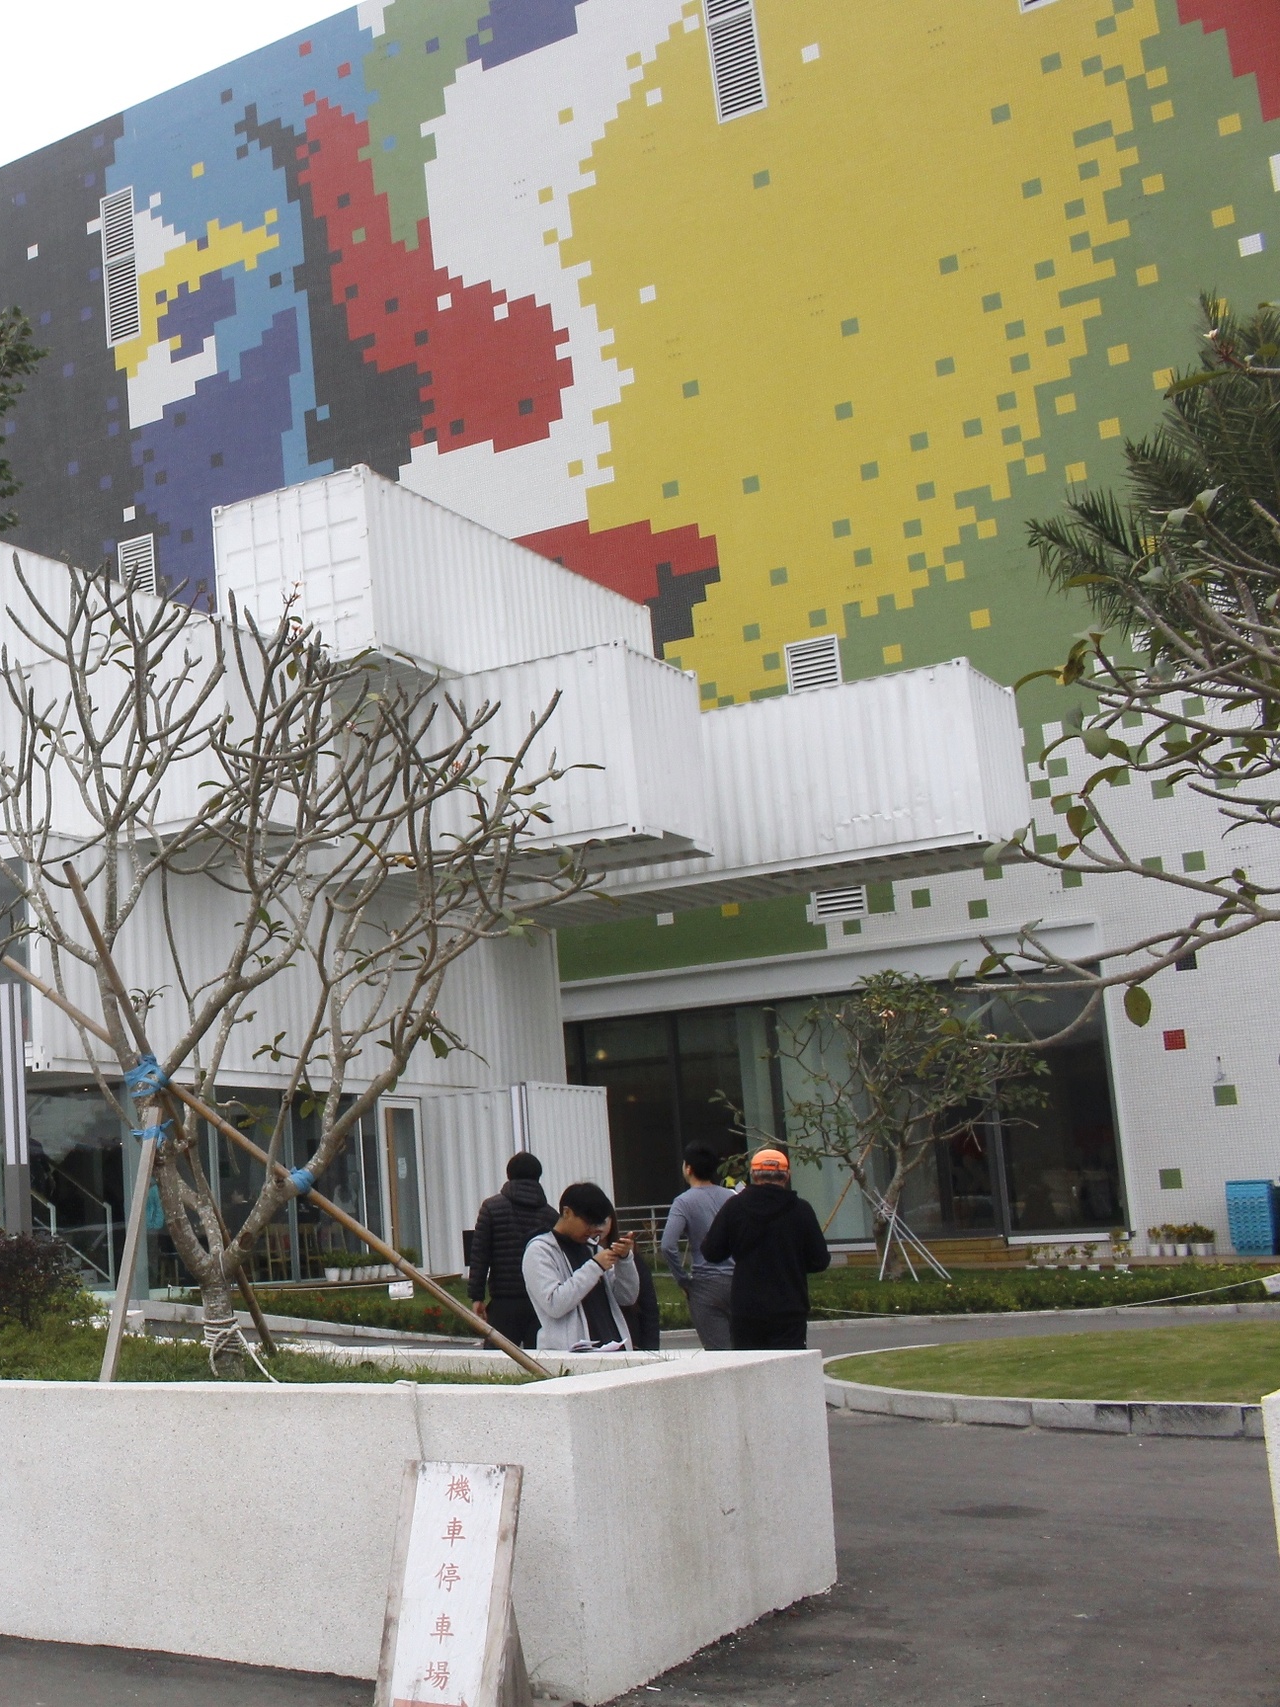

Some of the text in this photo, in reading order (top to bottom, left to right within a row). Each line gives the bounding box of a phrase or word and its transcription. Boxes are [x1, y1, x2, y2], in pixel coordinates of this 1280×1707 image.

[423, 1474, 472, 1691] 機車停車場
